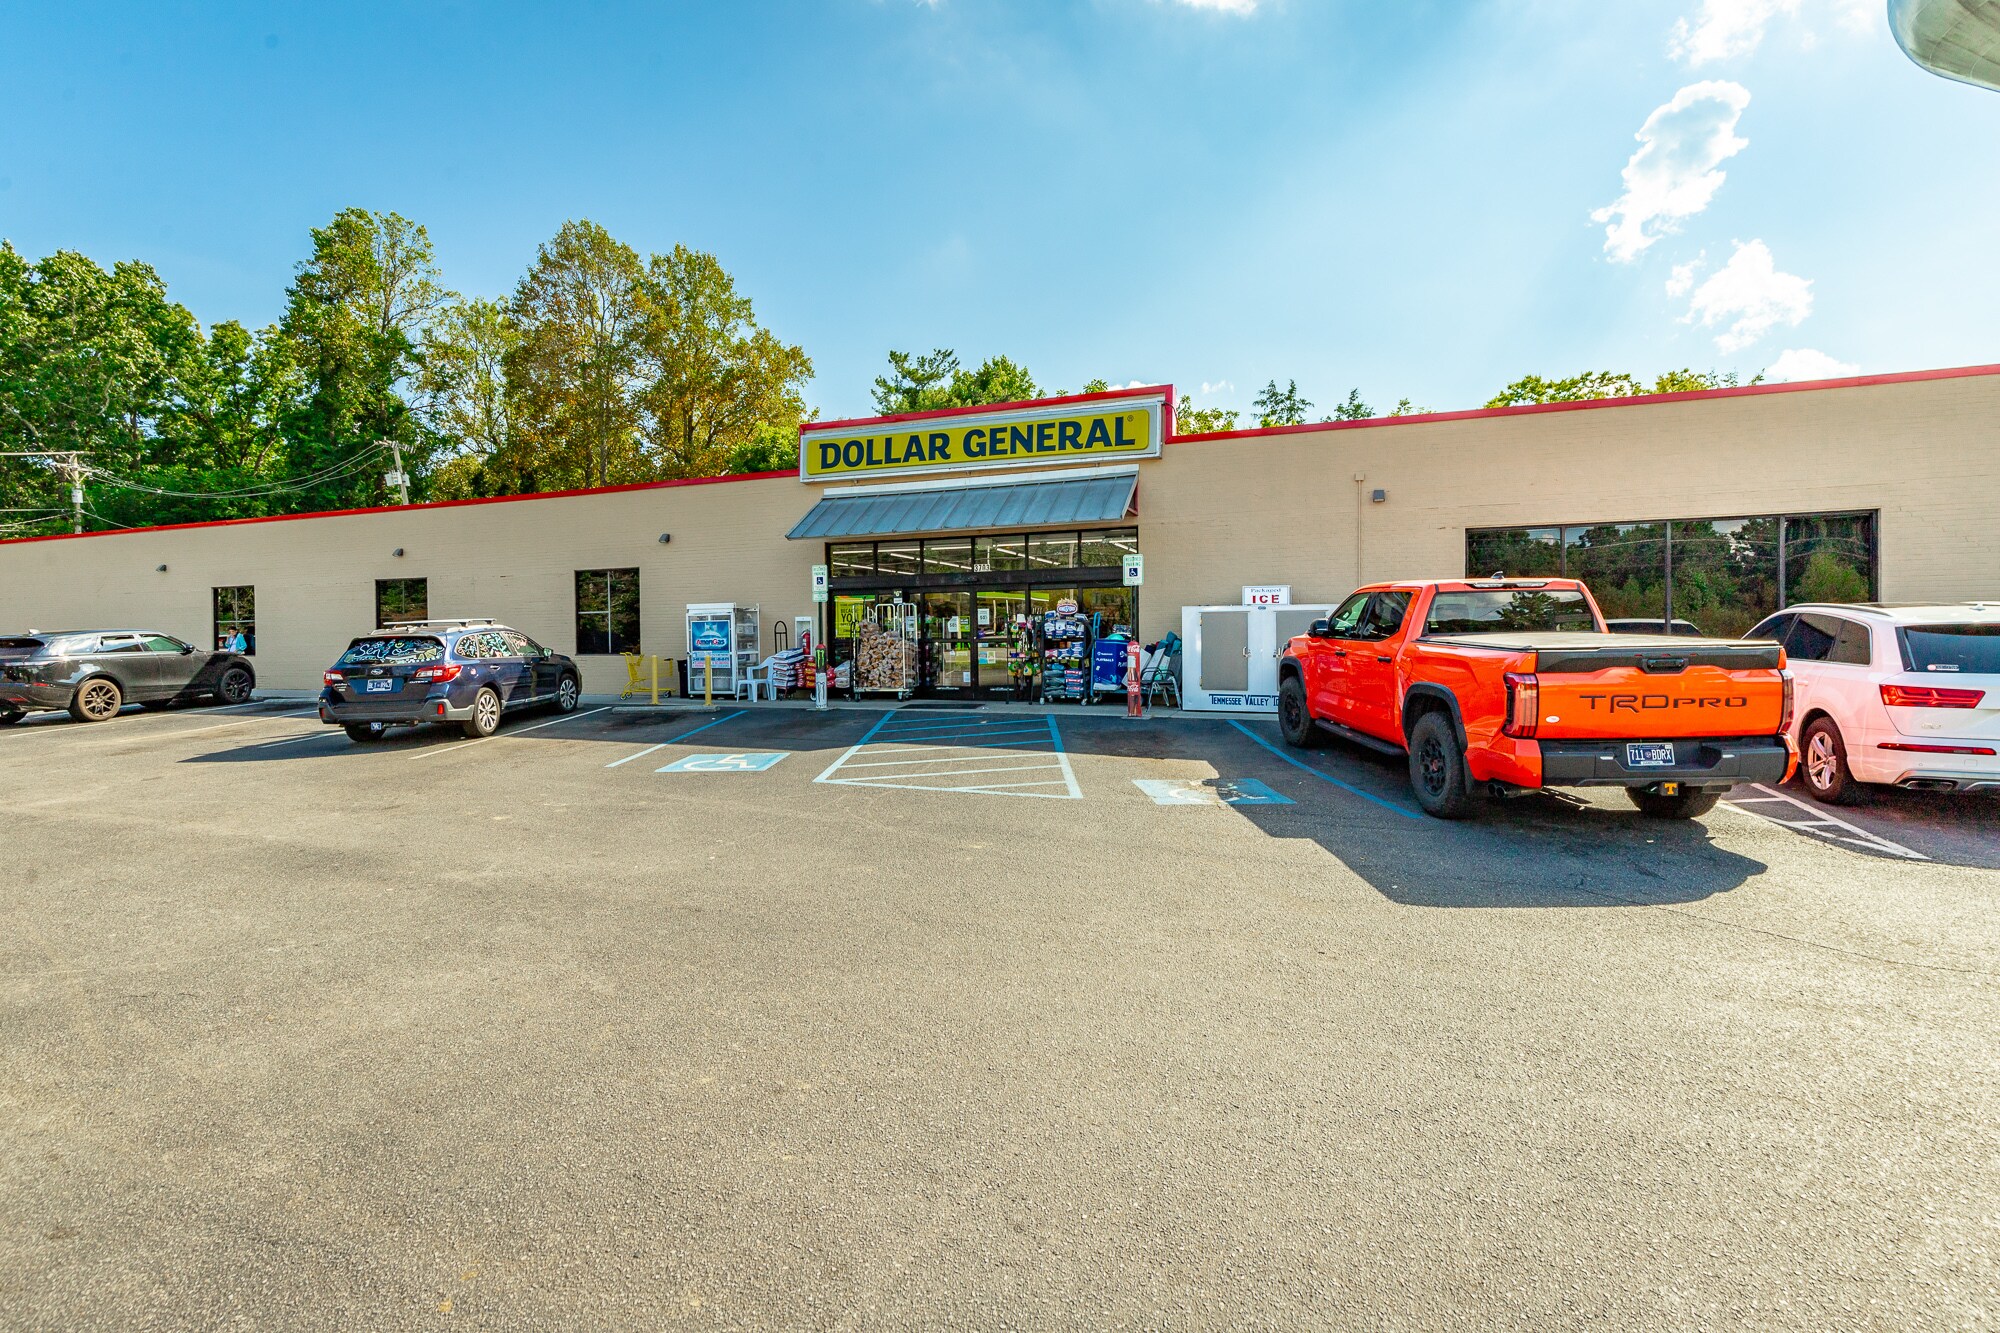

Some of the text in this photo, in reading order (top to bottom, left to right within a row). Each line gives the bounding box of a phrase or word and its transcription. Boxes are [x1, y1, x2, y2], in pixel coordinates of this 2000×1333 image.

[819, 415, 1136, 470] DOLLAR GENERAL
[1252, 594, 1280, 604] ICE
[1209, 694, 1243, 705] TENNESSEE
[1244, 695, 1271, 706] VALLEY
[1579, 694, 1748, 713] TRD PRO
[1630, 749, 1646, 761] 711
